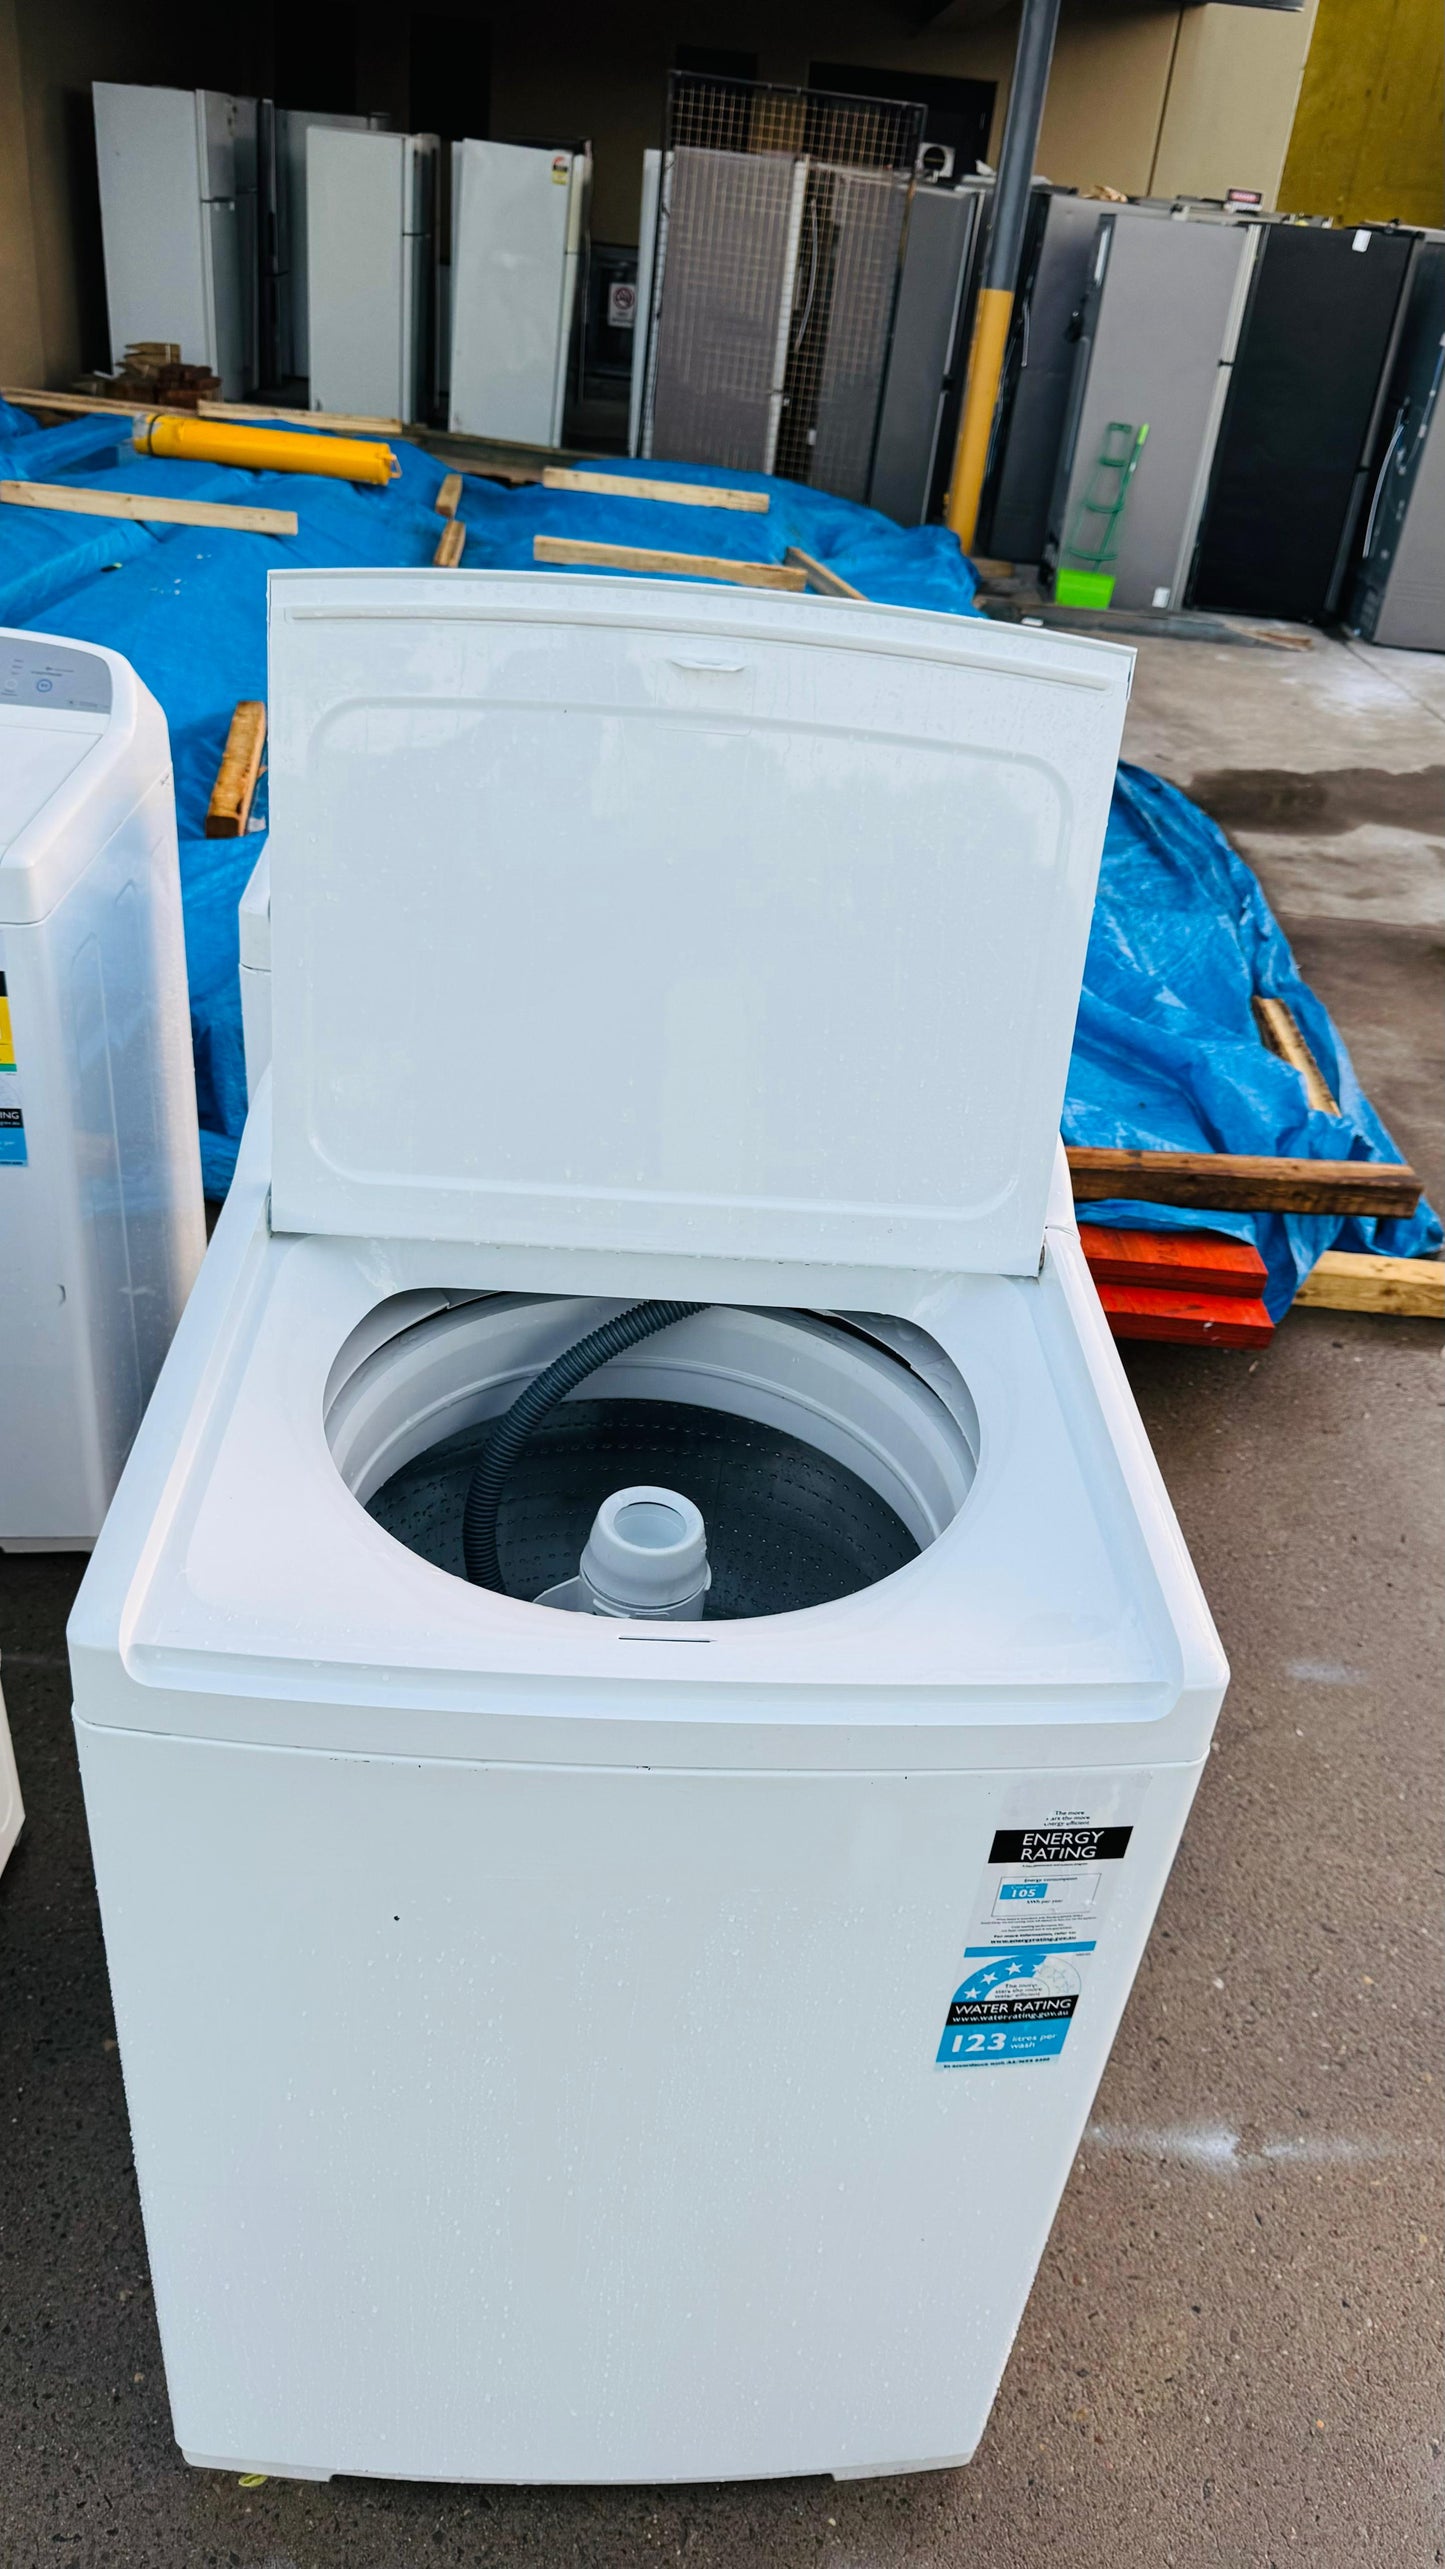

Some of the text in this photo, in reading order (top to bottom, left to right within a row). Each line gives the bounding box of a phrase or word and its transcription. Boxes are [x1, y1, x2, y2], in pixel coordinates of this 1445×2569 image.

[1022, 1830, 1105, 1846] ENERGY
[1020, 1845, 1098, 1861] RATING
[1012, 1889, 1037, 1898] 105
[955, 1999, 1072, 2015] WATER RATING
[951, 2032, 1007, 2053] 123
[1039, 2033, 1057, 2043] per
[1010, 2041, 1036, 2050] wash
